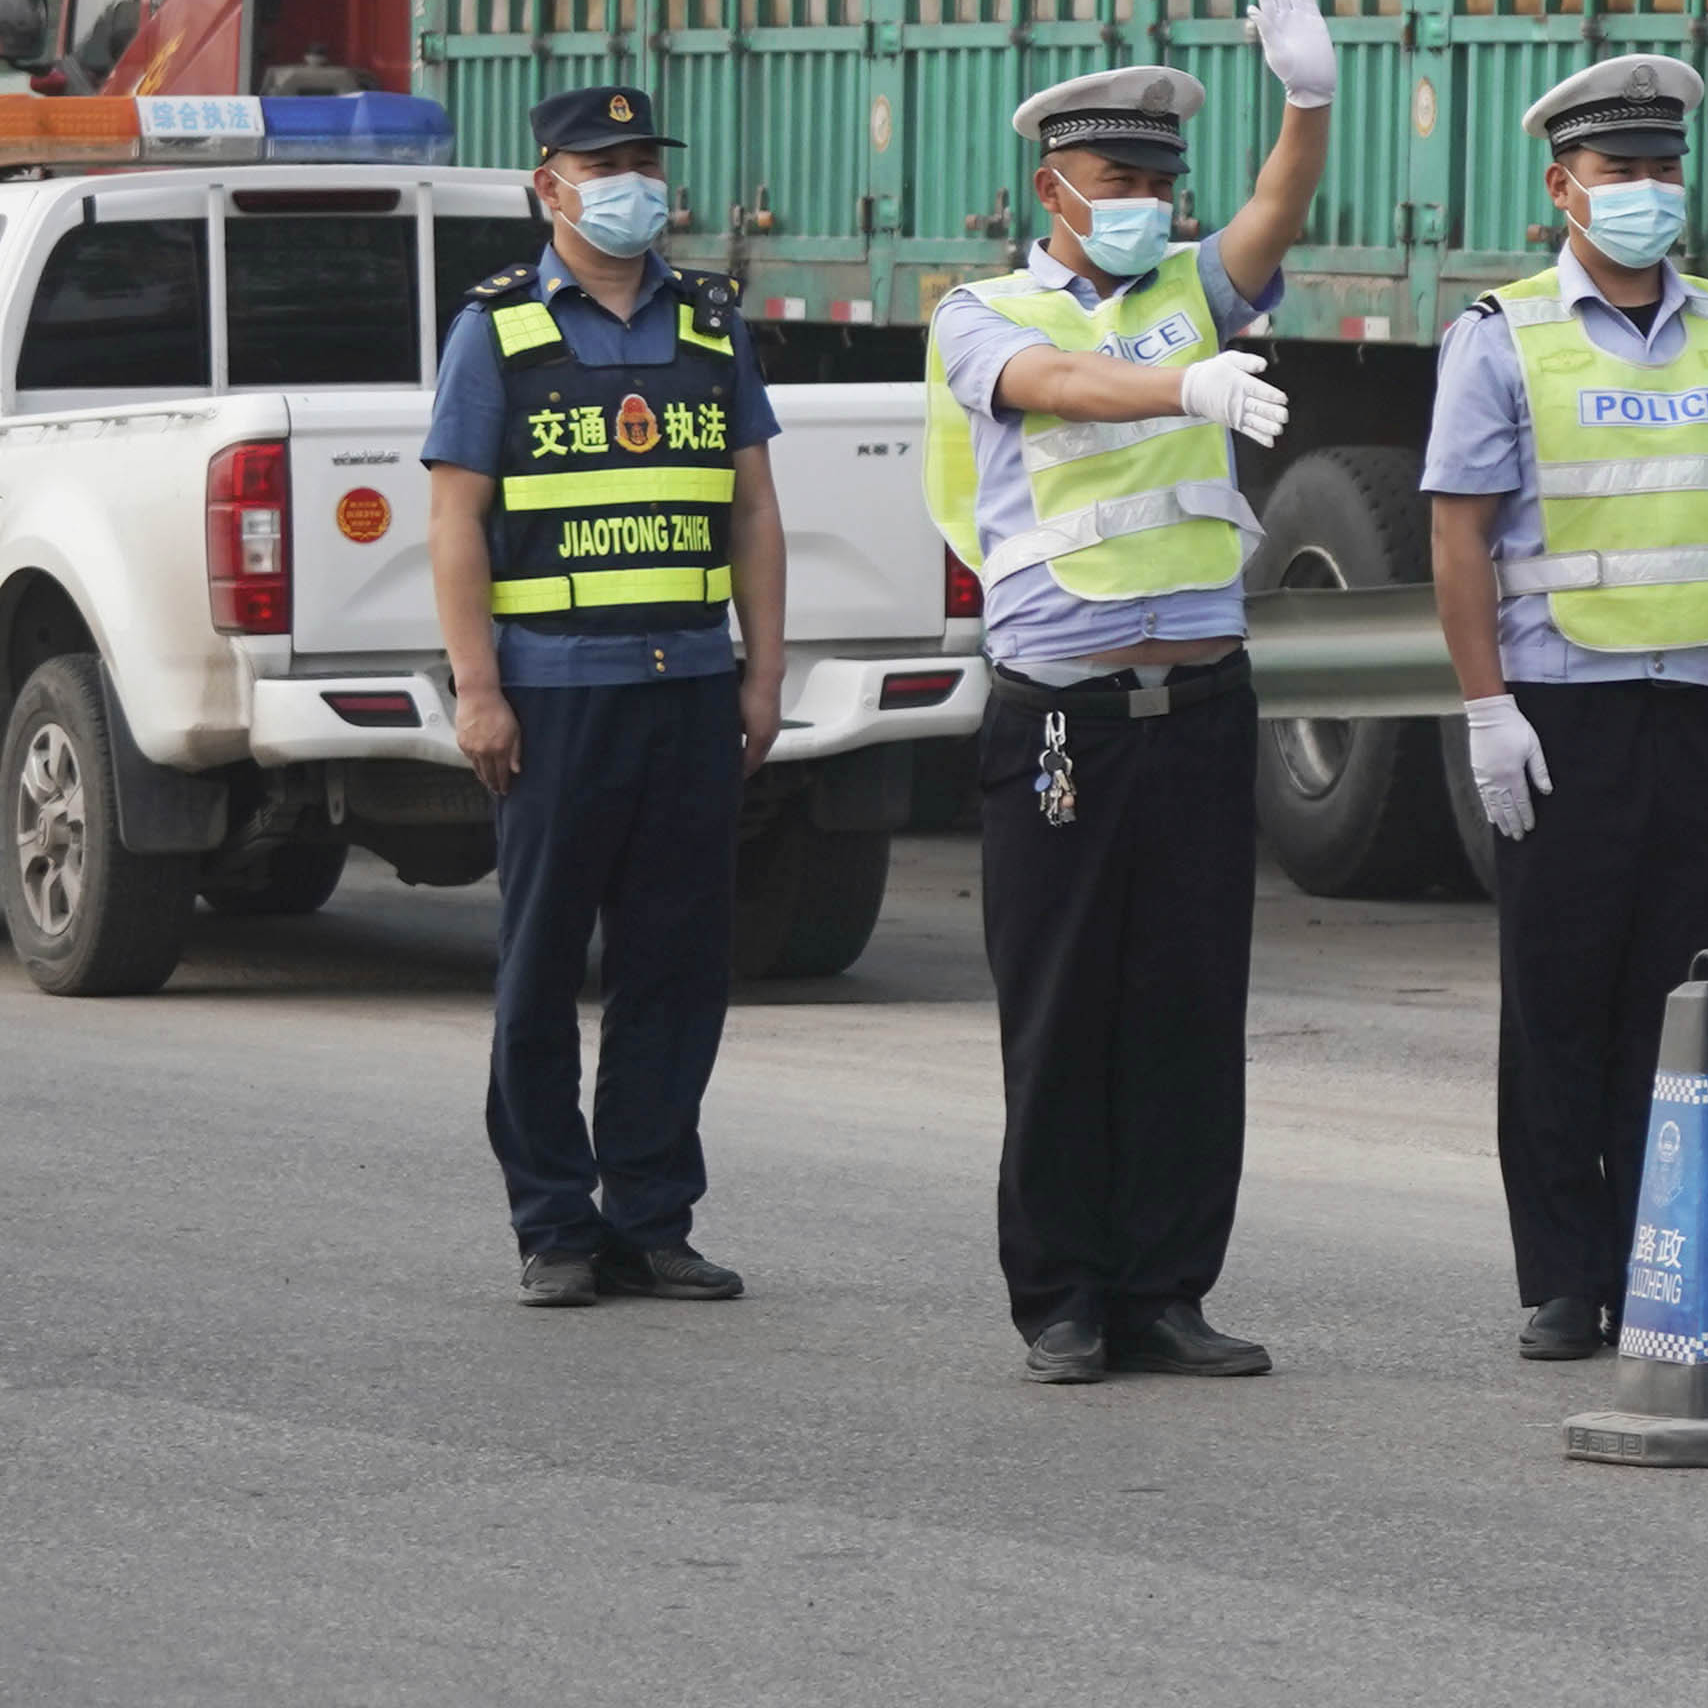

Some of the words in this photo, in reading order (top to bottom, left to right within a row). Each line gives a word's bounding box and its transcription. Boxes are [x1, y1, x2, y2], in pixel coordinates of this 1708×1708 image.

[151, 101, 250, 130] 综合执法
[528, 406, 610, 459] 交通
[663, 402, 727, 451] 执法
[558, 514, 669, 558] JIAOTONG
[672, 513, 712, 552] ZHIFA
[1635, 1224, 1687, 1269] 路政
[1631, 1267, 1684, 1305] LUZHENG
